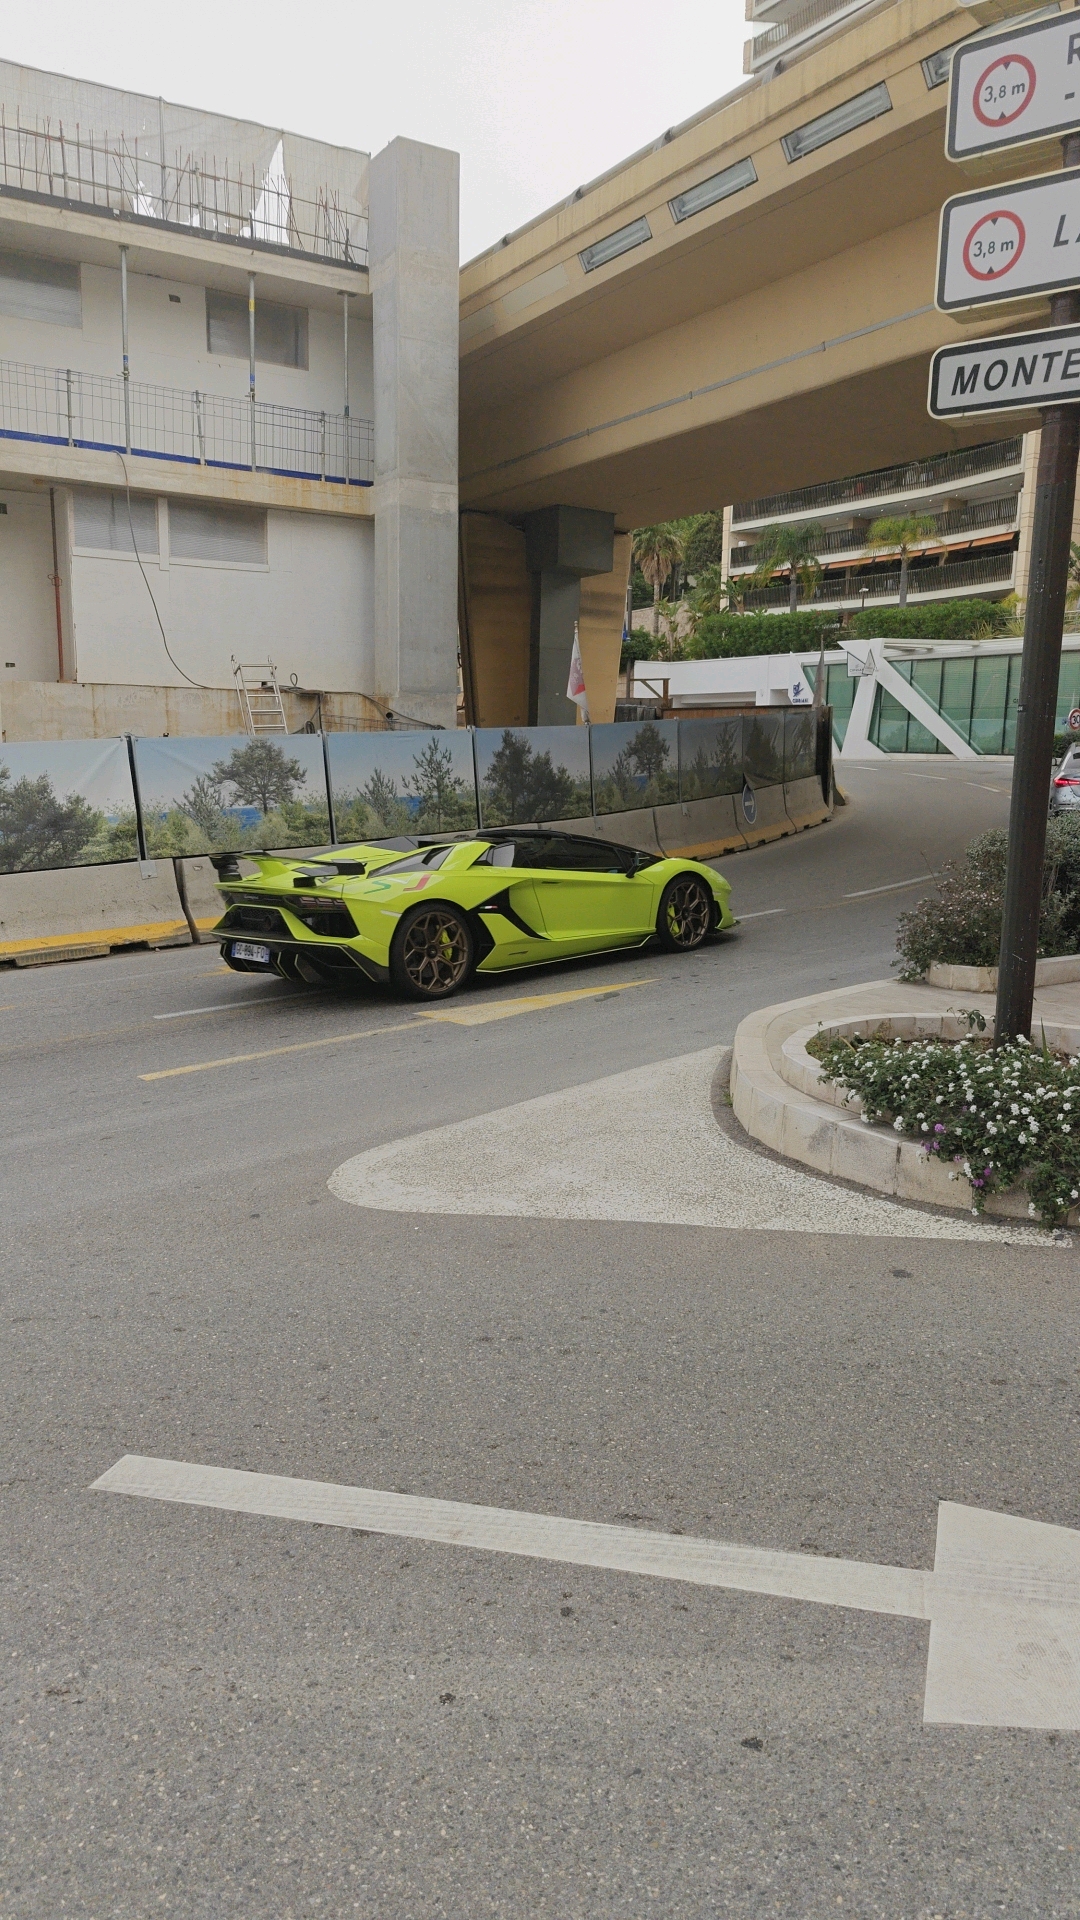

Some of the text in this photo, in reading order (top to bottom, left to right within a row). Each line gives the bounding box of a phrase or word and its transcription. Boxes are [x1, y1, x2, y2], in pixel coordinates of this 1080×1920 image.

[984, 82, 1025, 103] 3,8 m
[1053, 214, 1080, 248] L
[973, 240, 1014, 258] 3,8 m
[951, 348, 1080, 396] MONTE
